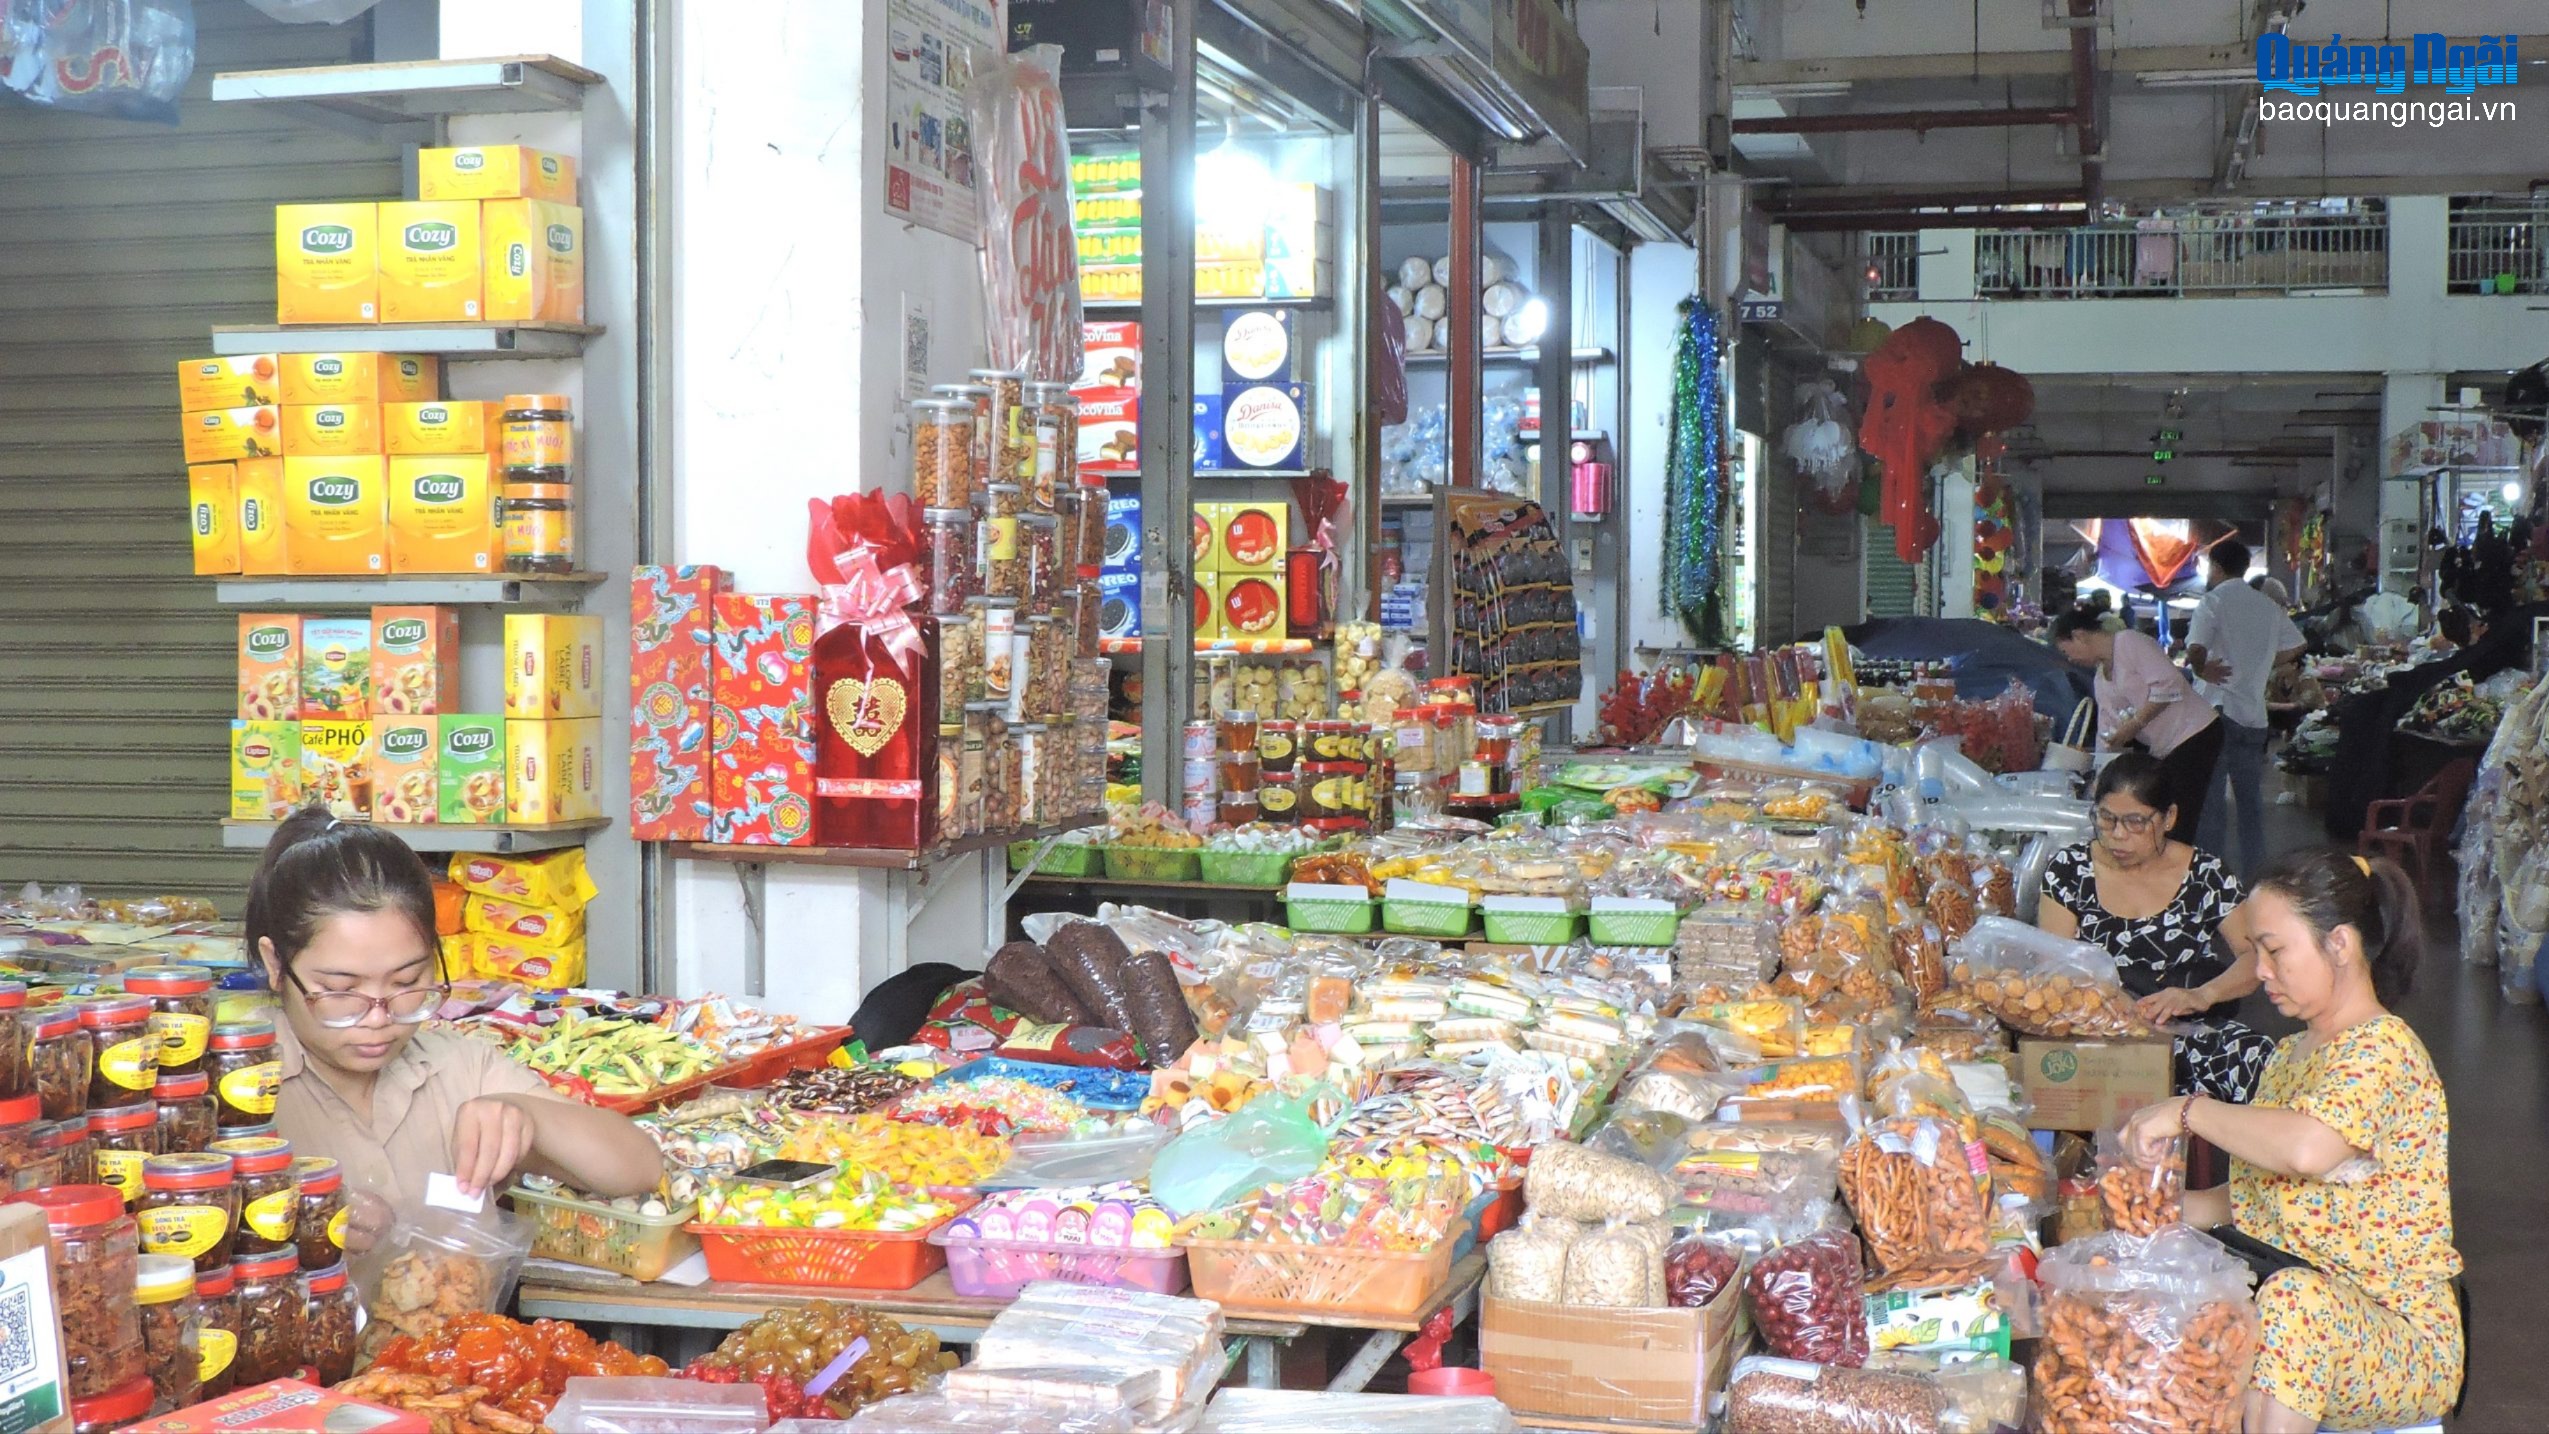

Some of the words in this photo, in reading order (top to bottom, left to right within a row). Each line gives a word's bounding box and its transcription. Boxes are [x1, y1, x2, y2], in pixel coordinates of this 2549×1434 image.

[306, 230, 348, 249] Cozy
[409, 227, 452, 246] Cozy
[511, 246, 525, 276] Cozy
[1082, 329, 1122, 343] coVina
[316, 362, 341, 374] Cozy
[318, 413, 343, 426] Cozy
[421, 410, 446, 422] Cozy
[313, 481, 355, 500] Cozy
[418, 479, 460, 498] Cozy
[1108, 499, 1140, 510] REO
[199, 505, 209, 534] Cozy
[246, 501, 256, 530] Cozy
[1103, 574, 1137, 586] REO
[252, 632, 286, 647] Cozy
[386, 625, 422, 640] Cozy
[302, 733, 324, 746] Café
[325, 723, 365, 746] PHỐ
[387, 733, 424, 749] Cozy
[453, 733, 489, 748] Cozy
